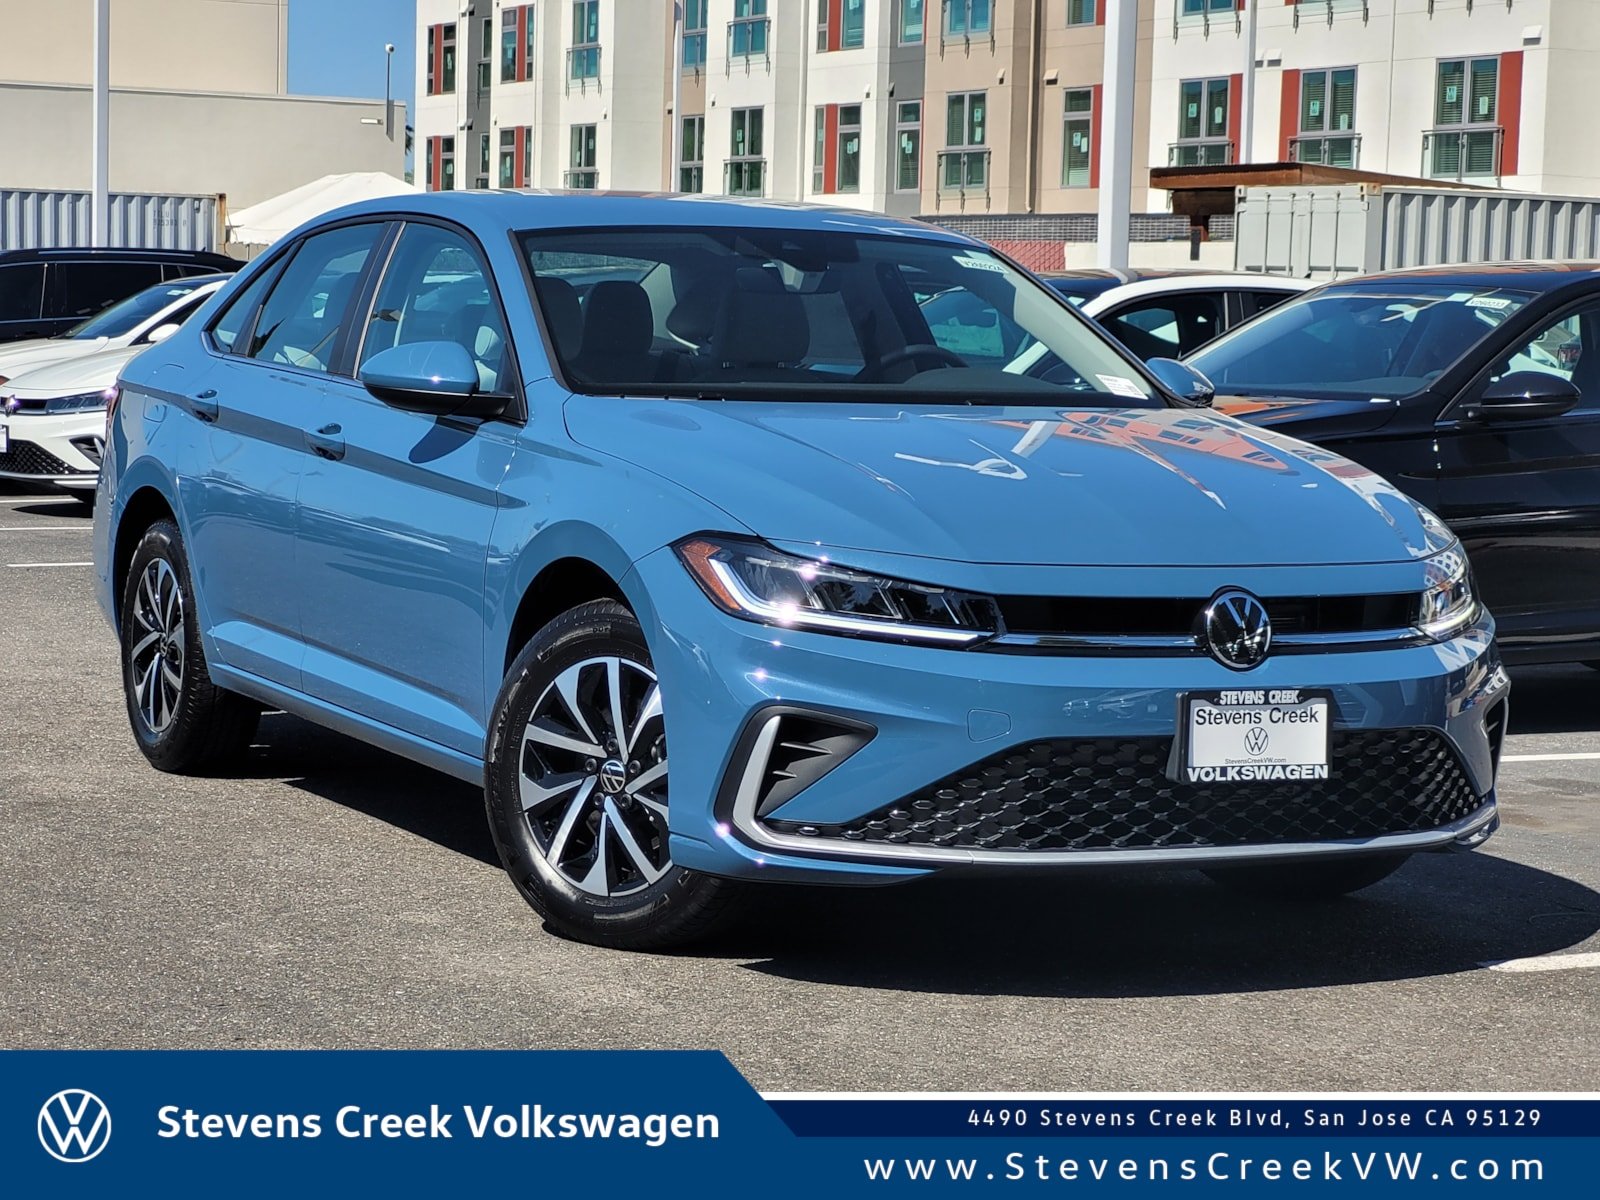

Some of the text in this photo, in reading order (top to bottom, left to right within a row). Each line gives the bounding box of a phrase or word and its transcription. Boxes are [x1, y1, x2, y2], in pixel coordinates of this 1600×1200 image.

[1220, 690, 1300, 705] STEVENS CREEK
[1195, 707, 1319, 725] Stevens Creek
[1225, 757, 1287, 765] StevensCreekVW.com
[1186, 765, 1329, 782] VOLKSWAGEN
